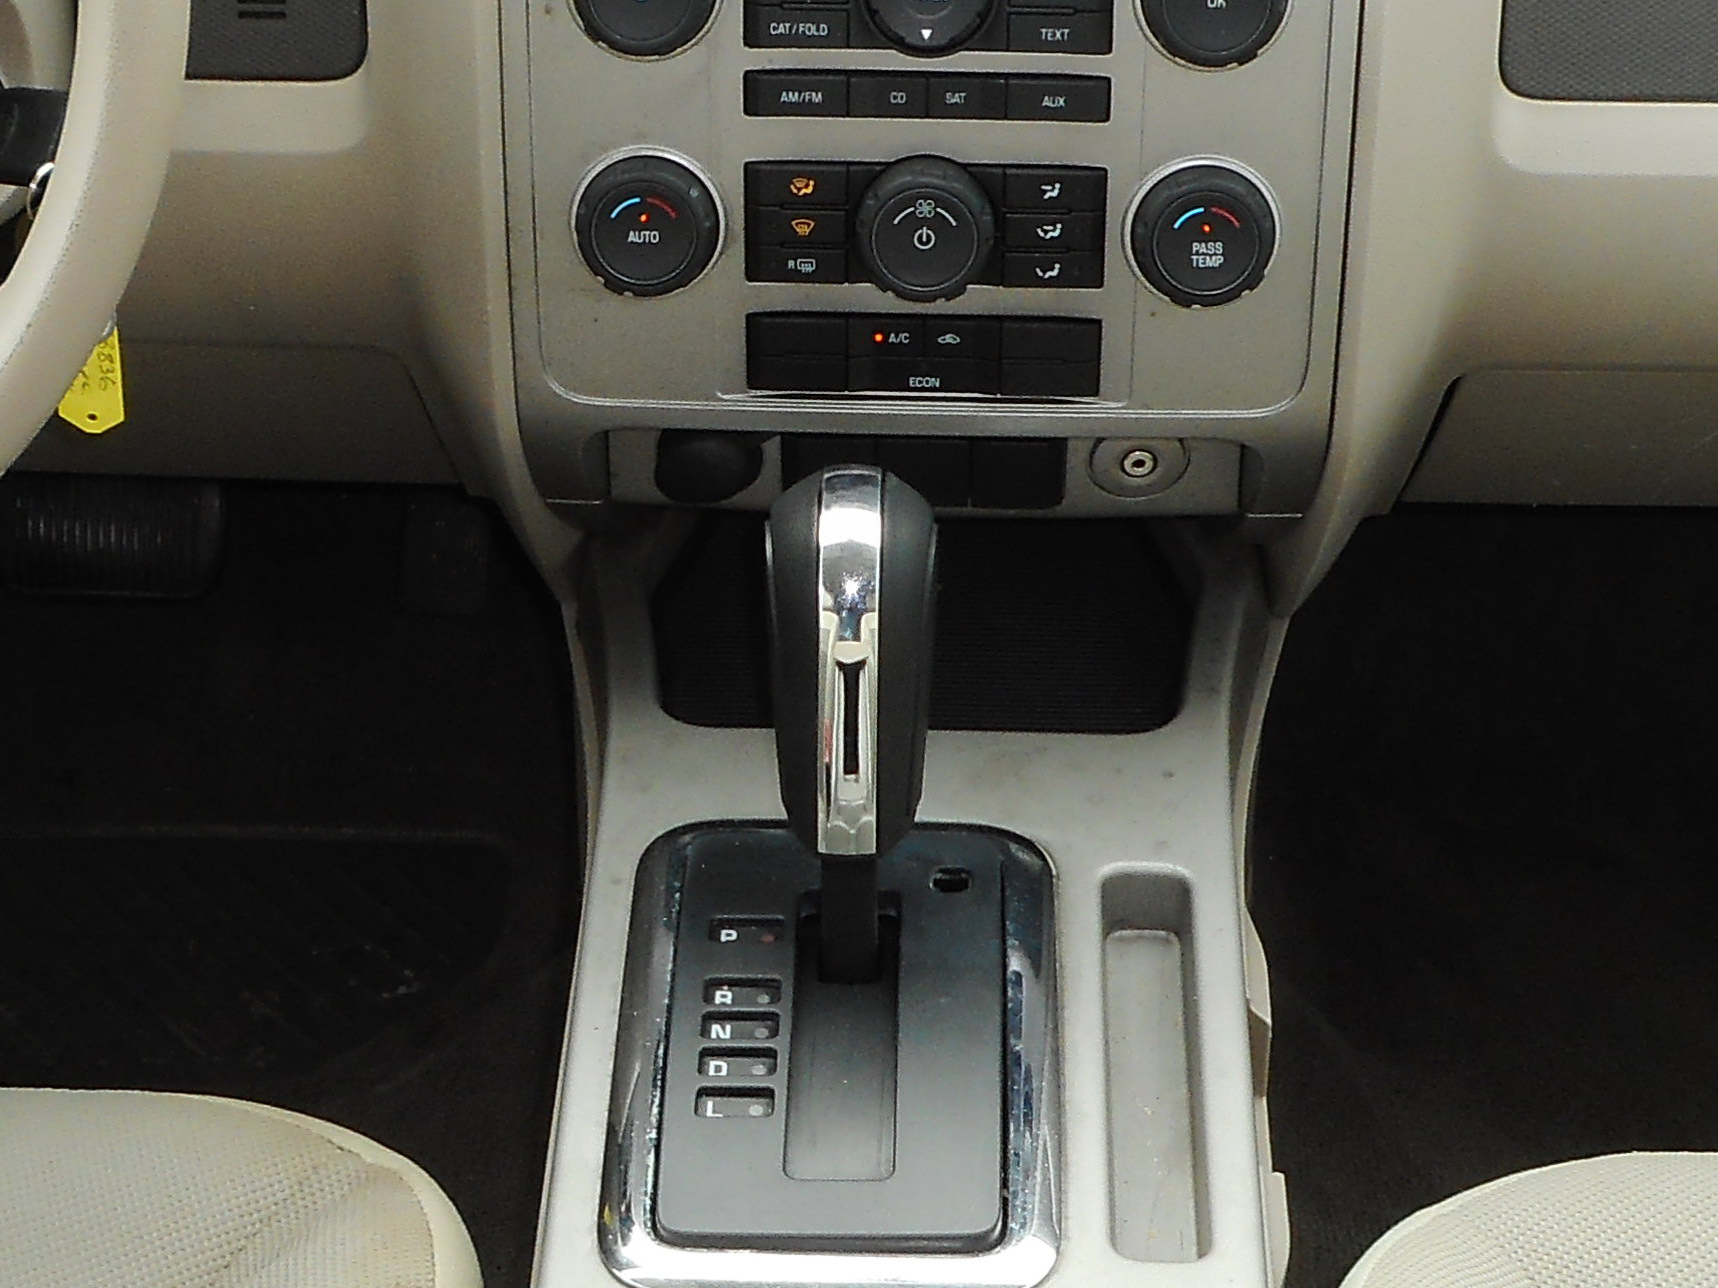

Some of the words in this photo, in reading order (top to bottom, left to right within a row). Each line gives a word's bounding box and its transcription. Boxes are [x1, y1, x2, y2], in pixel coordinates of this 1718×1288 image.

[1040, 28, 1070, 41] TEXT
[780, 90, 823, 103] AM/FM
[889, 91, 907, 104] CD
[945, 92, 967, 104] SAT
[1041, 95, 1066, 108] AUX
[627, 230, 660, 244] AUTO
[1191, 241, 1223, 257] PASS
[1190, 255, 1224, 268] TEMP
[888, 332, 910, 344] A/C
[909, 376, 940, 388] ECON
[719, 929, 738, 943] P
[714, 990, 733, 1005] R
[711, 1024, 731, 1039] N
[708, 1061, 728, 1077] D
[705, 1101, 723, 1117] L
